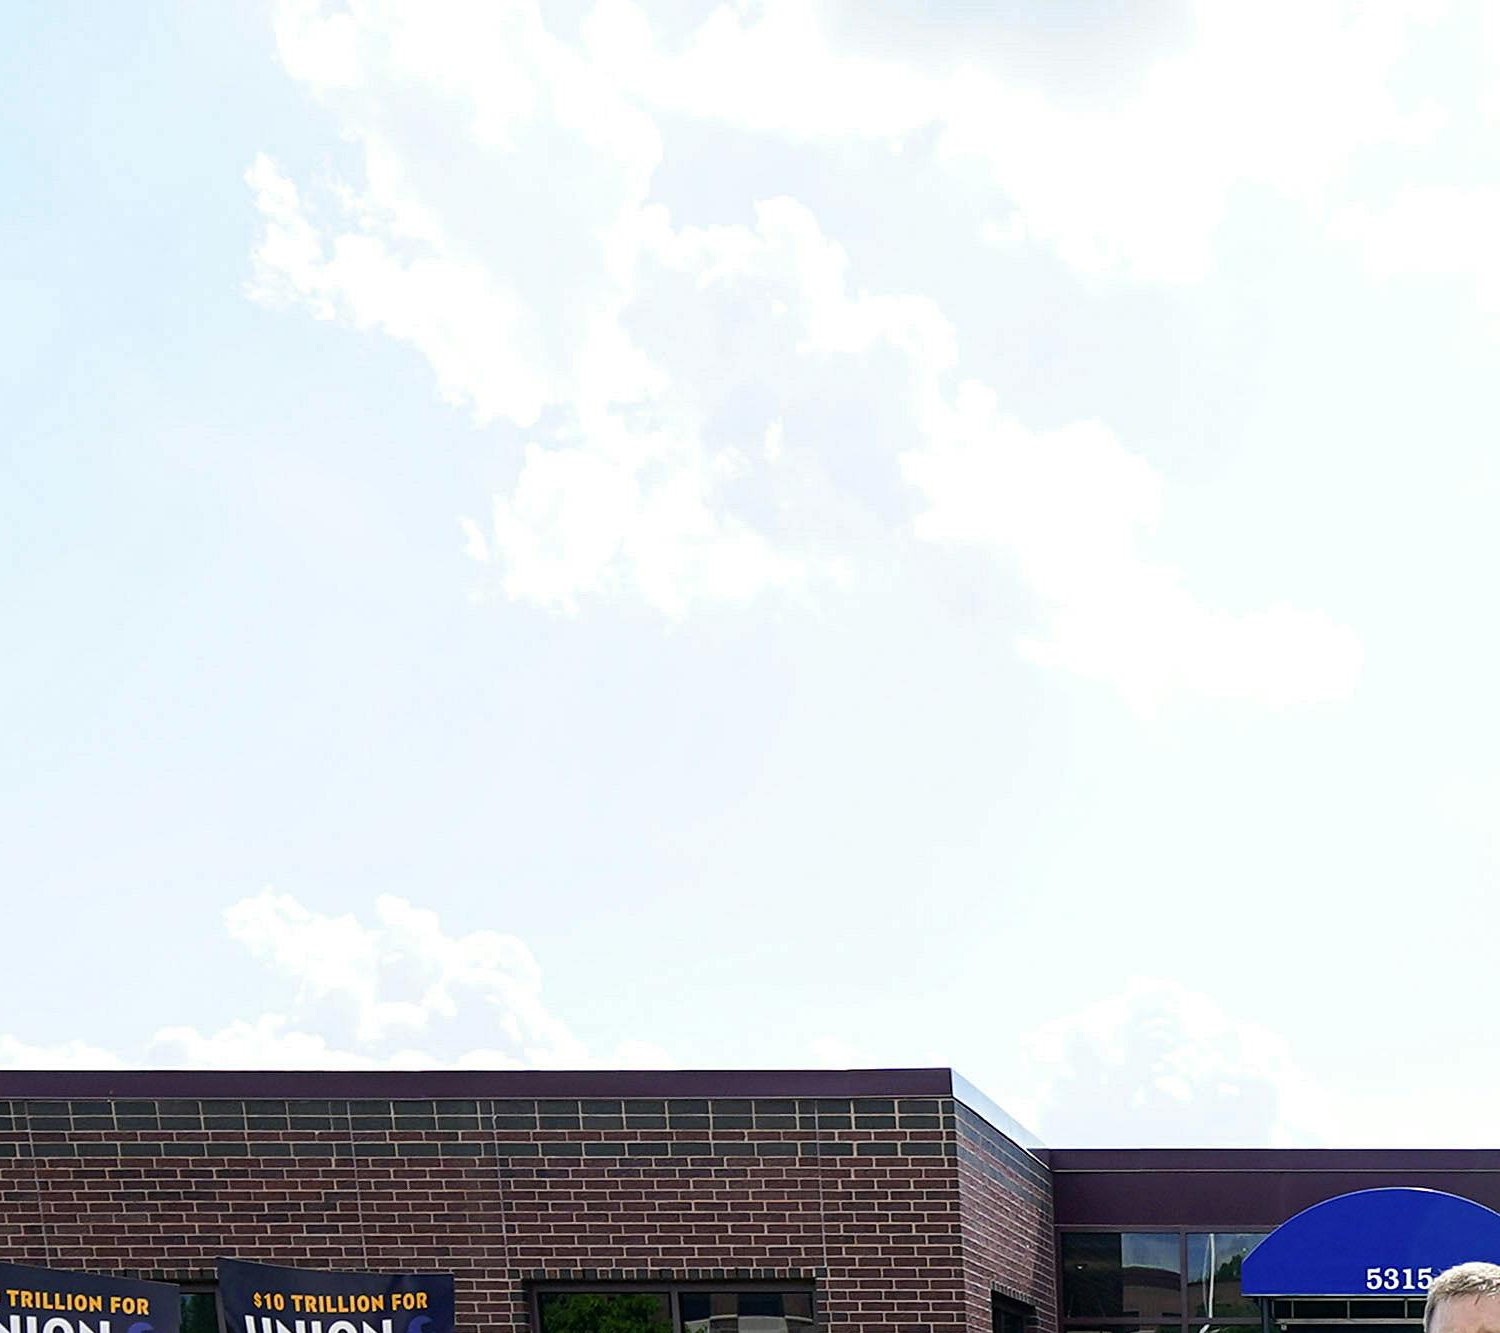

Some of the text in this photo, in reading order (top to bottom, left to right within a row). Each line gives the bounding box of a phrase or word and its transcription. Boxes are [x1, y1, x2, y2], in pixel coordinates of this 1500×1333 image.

[1366, 1267, 1433, 1290] 5315
[7, 1290, 101, 1311] TRILLION
[111, 1297, 148, 1314] FOR
[254, 1293, 427, 1312] $10 TRILLION FOR
